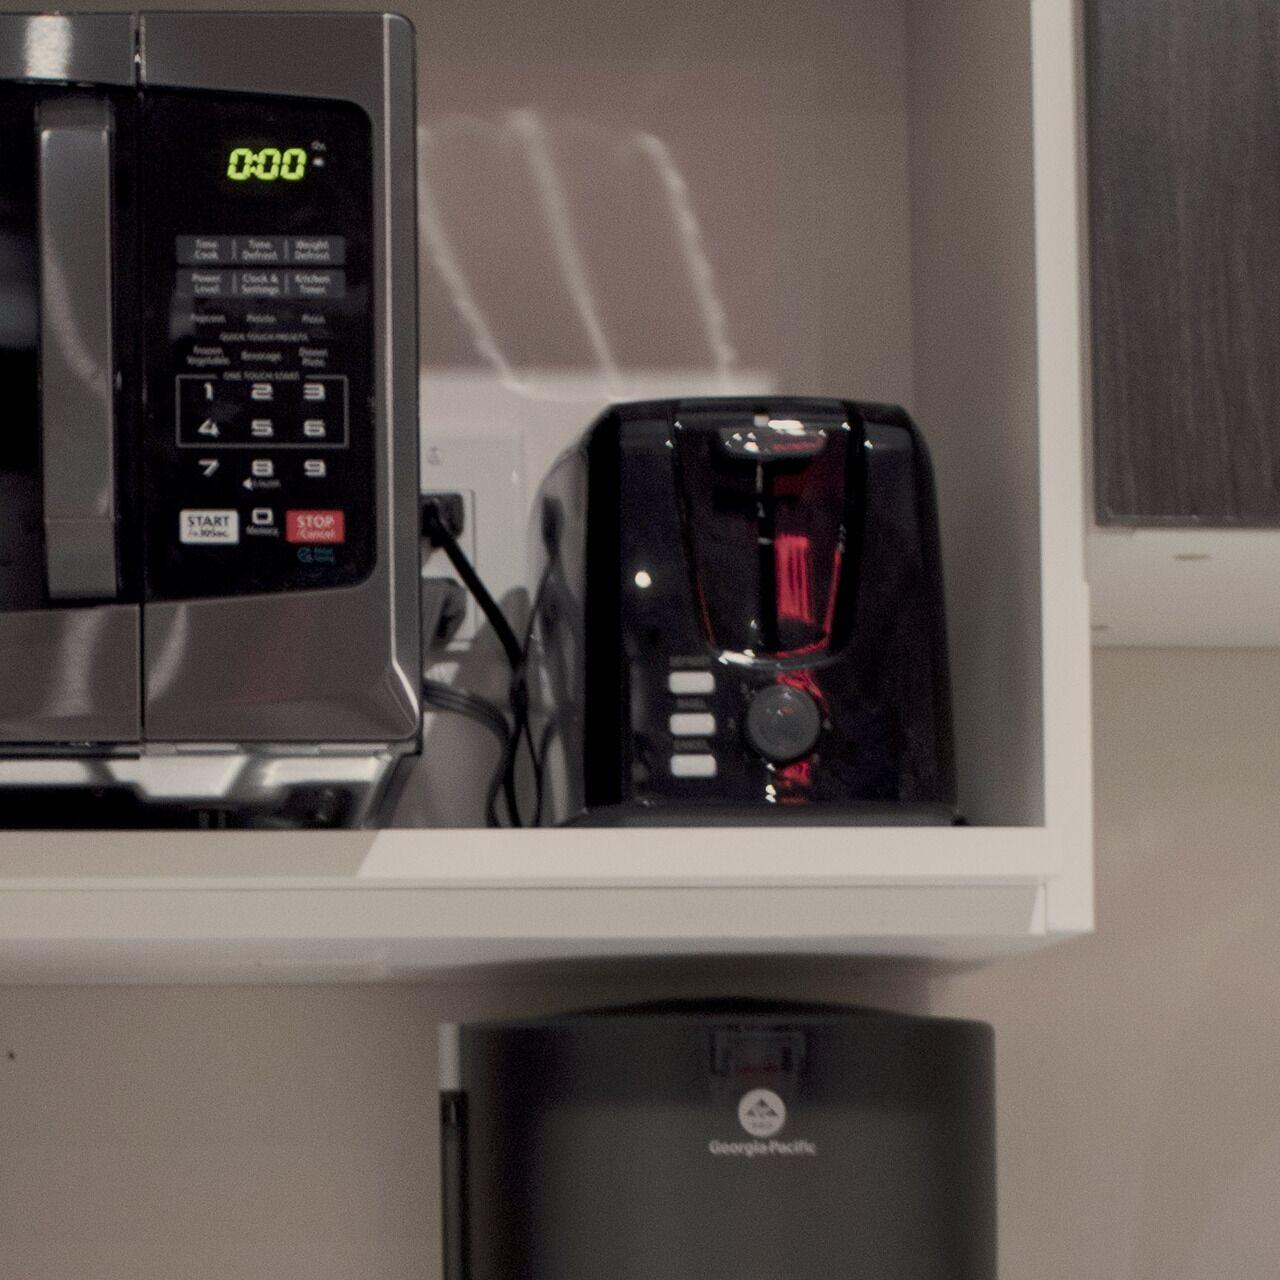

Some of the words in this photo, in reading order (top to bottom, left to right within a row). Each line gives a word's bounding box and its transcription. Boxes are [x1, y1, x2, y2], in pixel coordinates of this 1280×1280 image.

[227, 148, 308, 180] 0:00
[203, 382, 214, 400] 1
[250, 383, 274, 400] 2
[303, 383, 325, 400] 3
[197, 419, 220, 437] 4
[250, 419, 274, 437] 5
[197, 459, 219, 477] 7
[304, 459, 326, 477] 9
[187, 516, 229, 527] START
[297, 515, 335, 528] STOP
